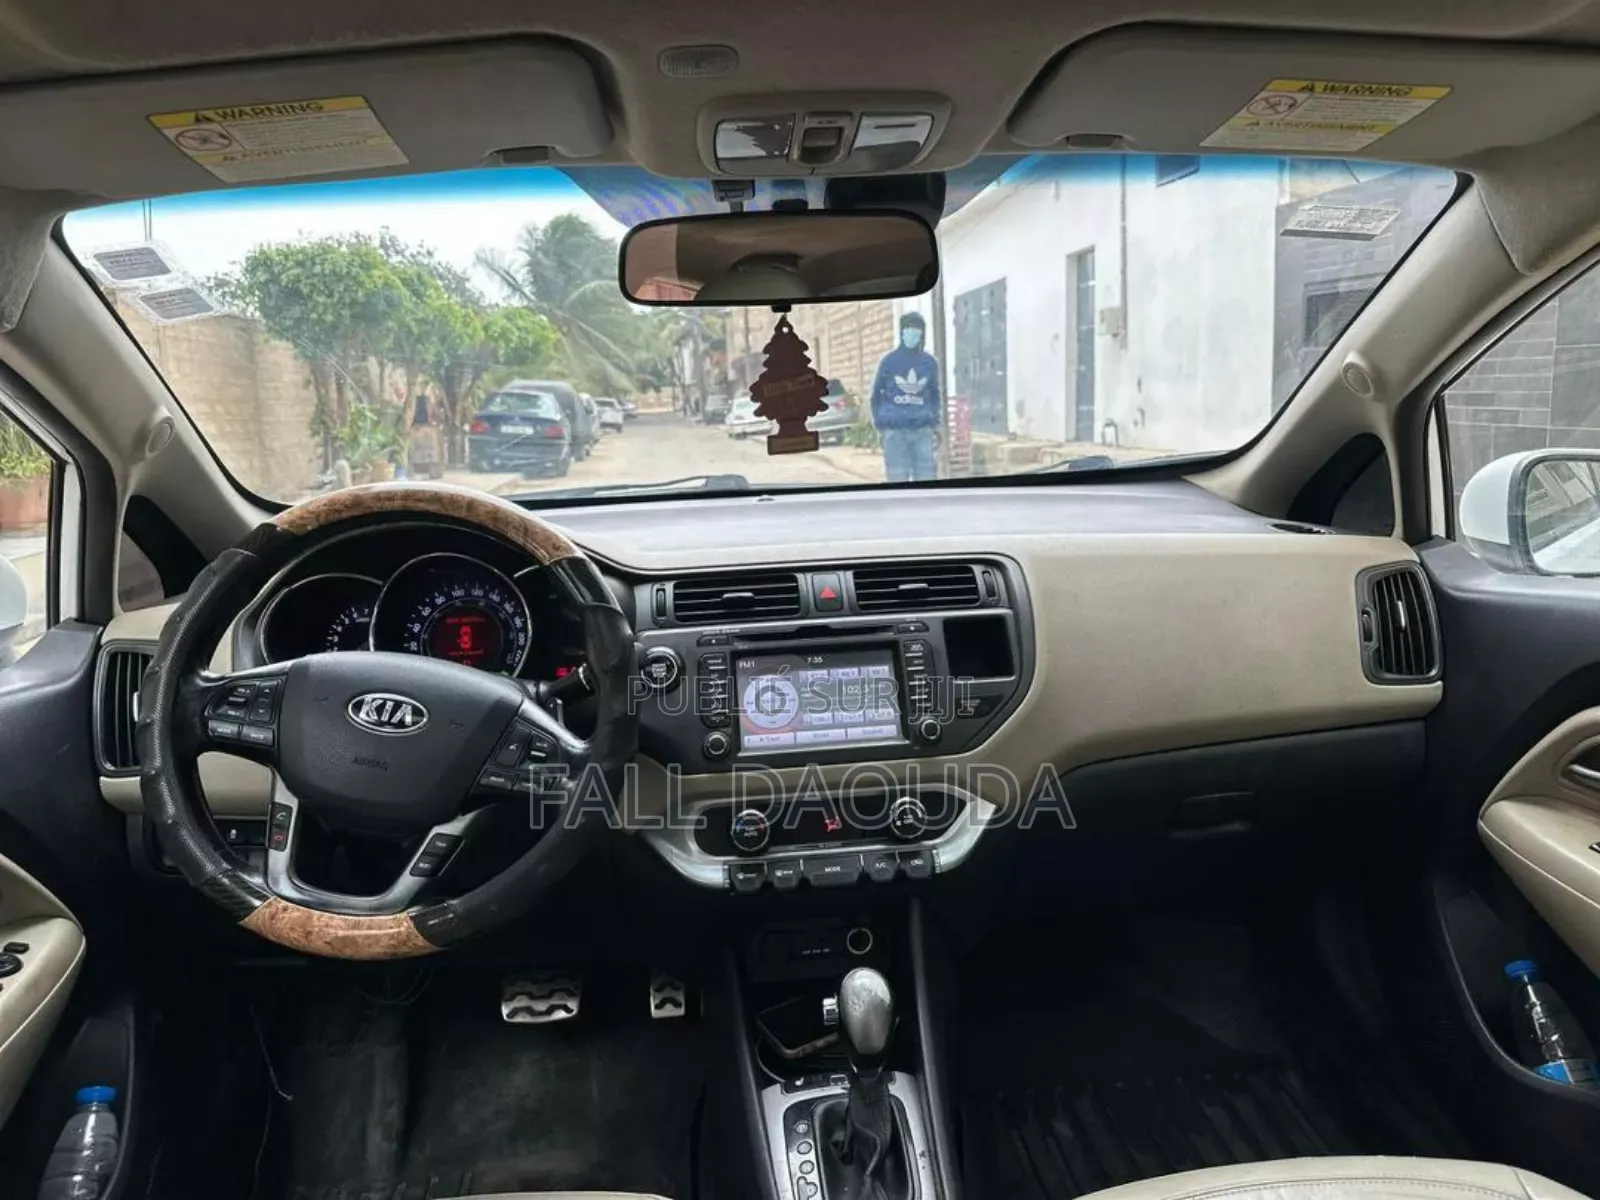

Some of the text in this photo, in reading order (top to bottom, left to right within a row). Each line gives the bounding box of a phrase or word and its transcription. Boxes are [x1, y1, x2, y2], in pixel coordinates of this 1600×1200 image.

[1322, 83, 1413, 96] WARNING
[214, 101, 324, 120] WARNING
[358, 698, 413, 726] KIA
[824, 865, 841, 873] MODE
